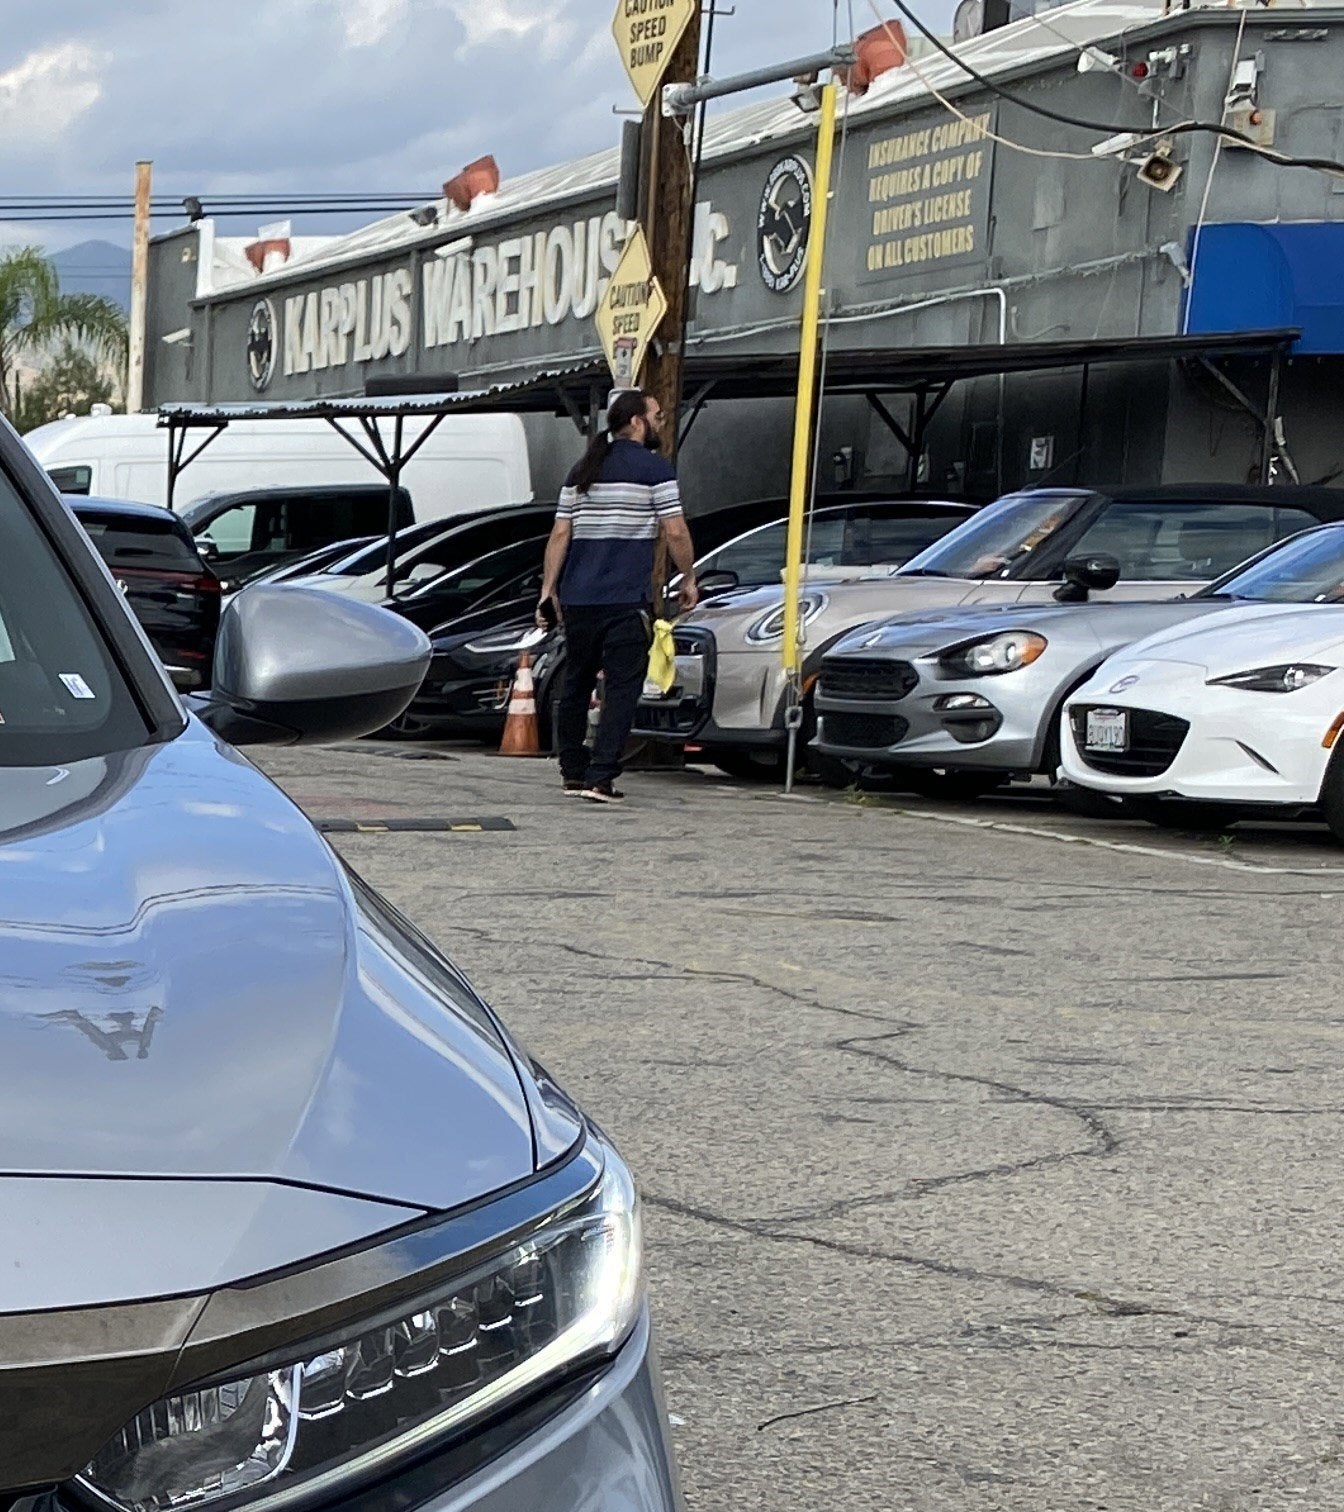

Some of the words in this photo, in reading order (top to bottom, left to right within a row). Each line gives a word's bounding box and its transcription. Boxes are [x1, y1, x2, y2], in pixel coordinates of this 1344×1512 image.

[630, 16, 667, 43] SPEED
[630, 42, 664, 69] BUMP
[868, 129, 932, 169] INSURANCE
[931, 112, 992, 153] COMPANY
[868, 166, 923, 202] REQUIRES
[921, 163, 932, 190] A
[932, 155, 965, 187] COPY
[965, 151, 983, 180] OF
[873, 201, 923, 236] DRIVER'S
[923, 188, 972, 225] LICENSE
[867, 244, 884, 272] ON
[883, 240, 904, 268] ALL
[904, 224, 975, 263] CUSTOMERS
[284, 268, 412, 377] KARPLUS
[423, 210, 638, 349] WAREHOUS
[688, 200, 738, 294] C.
[612, 312, 641, 336] SPEED
